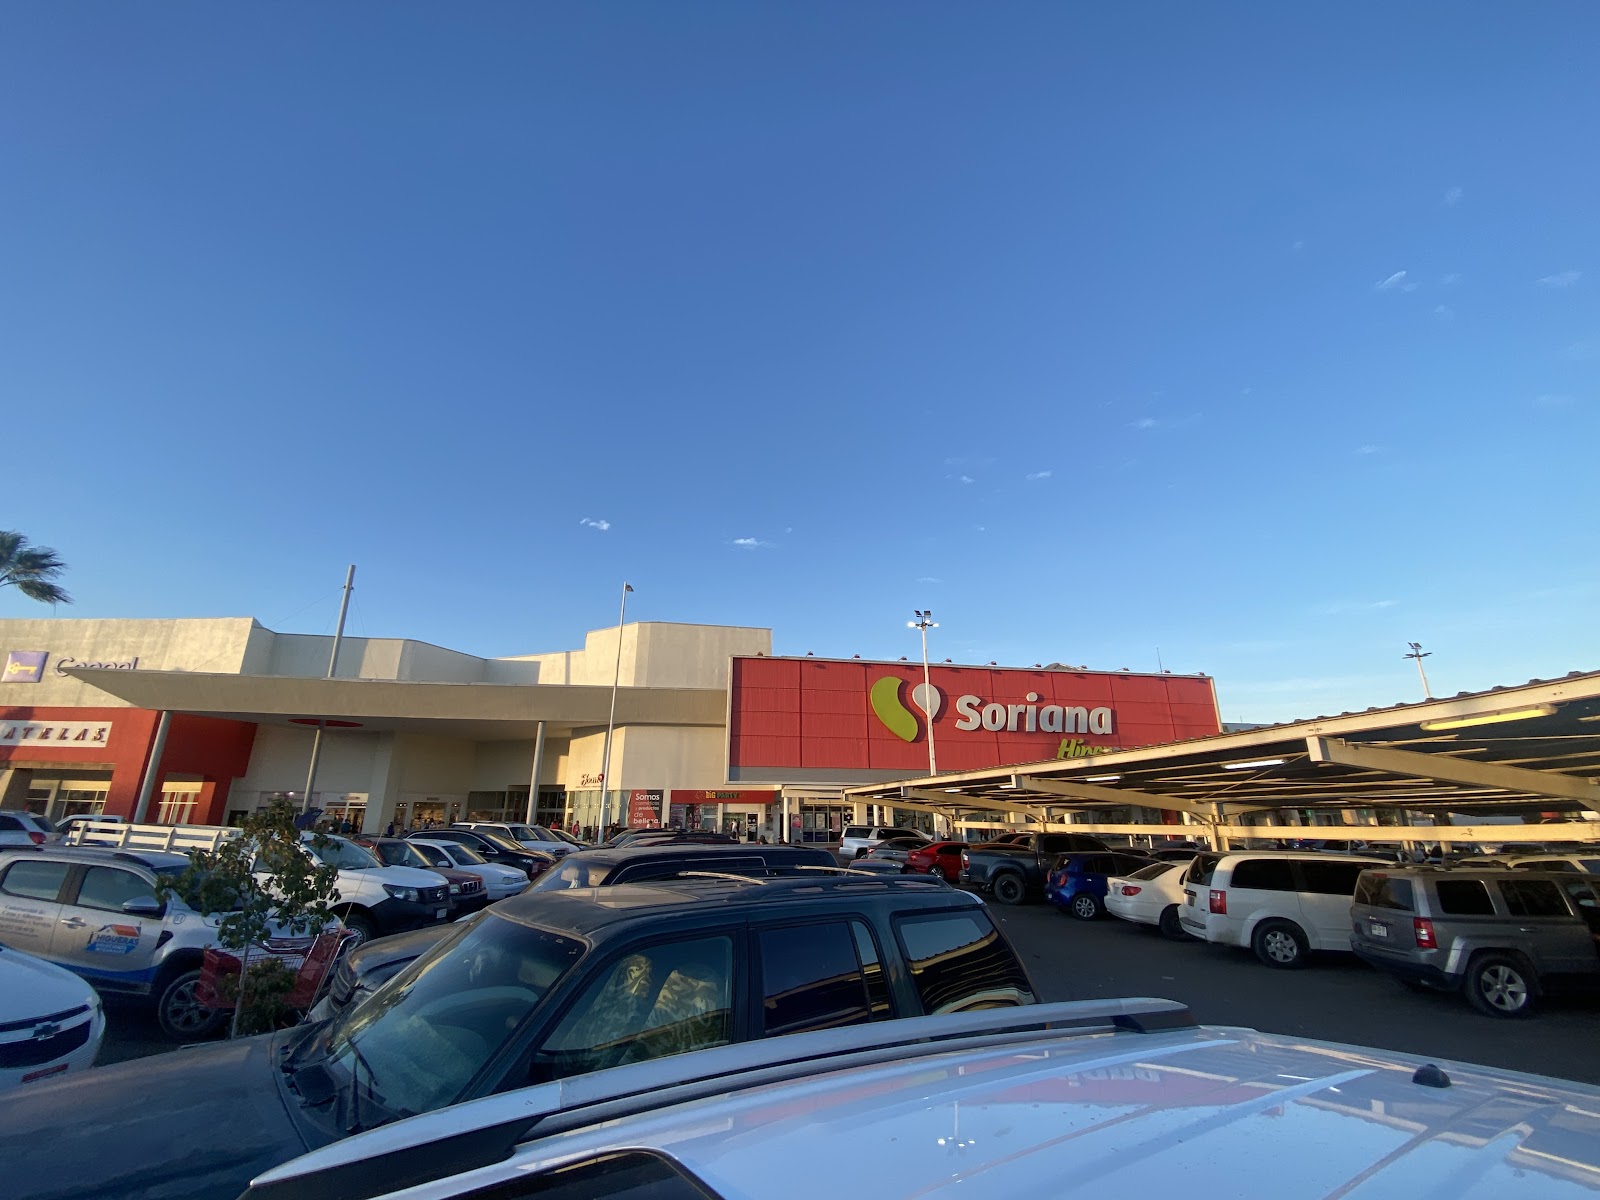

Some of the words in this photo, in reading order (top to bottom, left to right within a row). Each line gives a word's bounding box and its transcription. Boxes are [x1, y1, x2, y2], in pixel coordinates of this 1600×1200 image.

[954, 691, 1113, 735] Soriana
[635, 793, 660, 801] Somos
[96, 934, 140, 945] HIGUERAS
